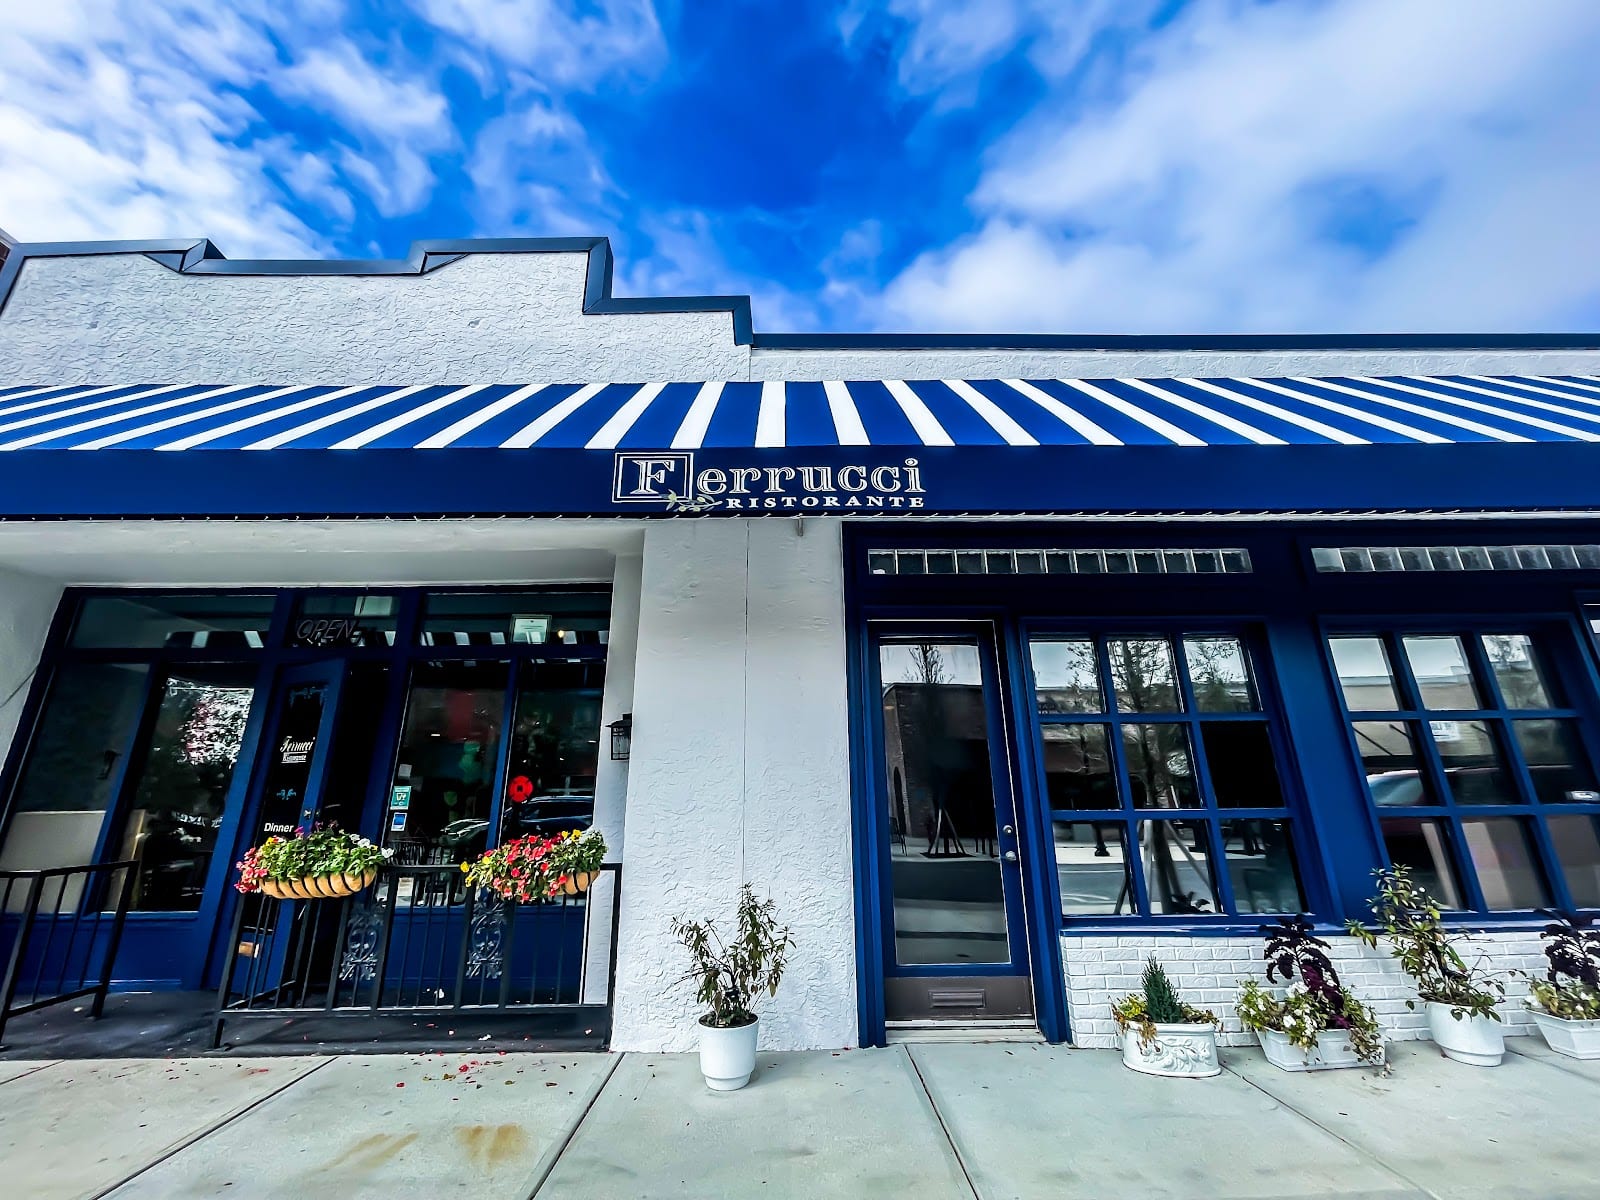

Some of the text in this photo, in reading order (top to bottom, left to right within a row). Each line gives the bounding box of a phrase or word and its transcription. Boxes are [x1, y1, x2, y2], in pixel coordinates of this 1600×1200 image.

[631, 458, 926, 494] Ferrucci
[726, 496, 925, 508] RISTORANTE
[297, 619, 356, 639] OPEN
[264, 822, 294, 832] Dinner
